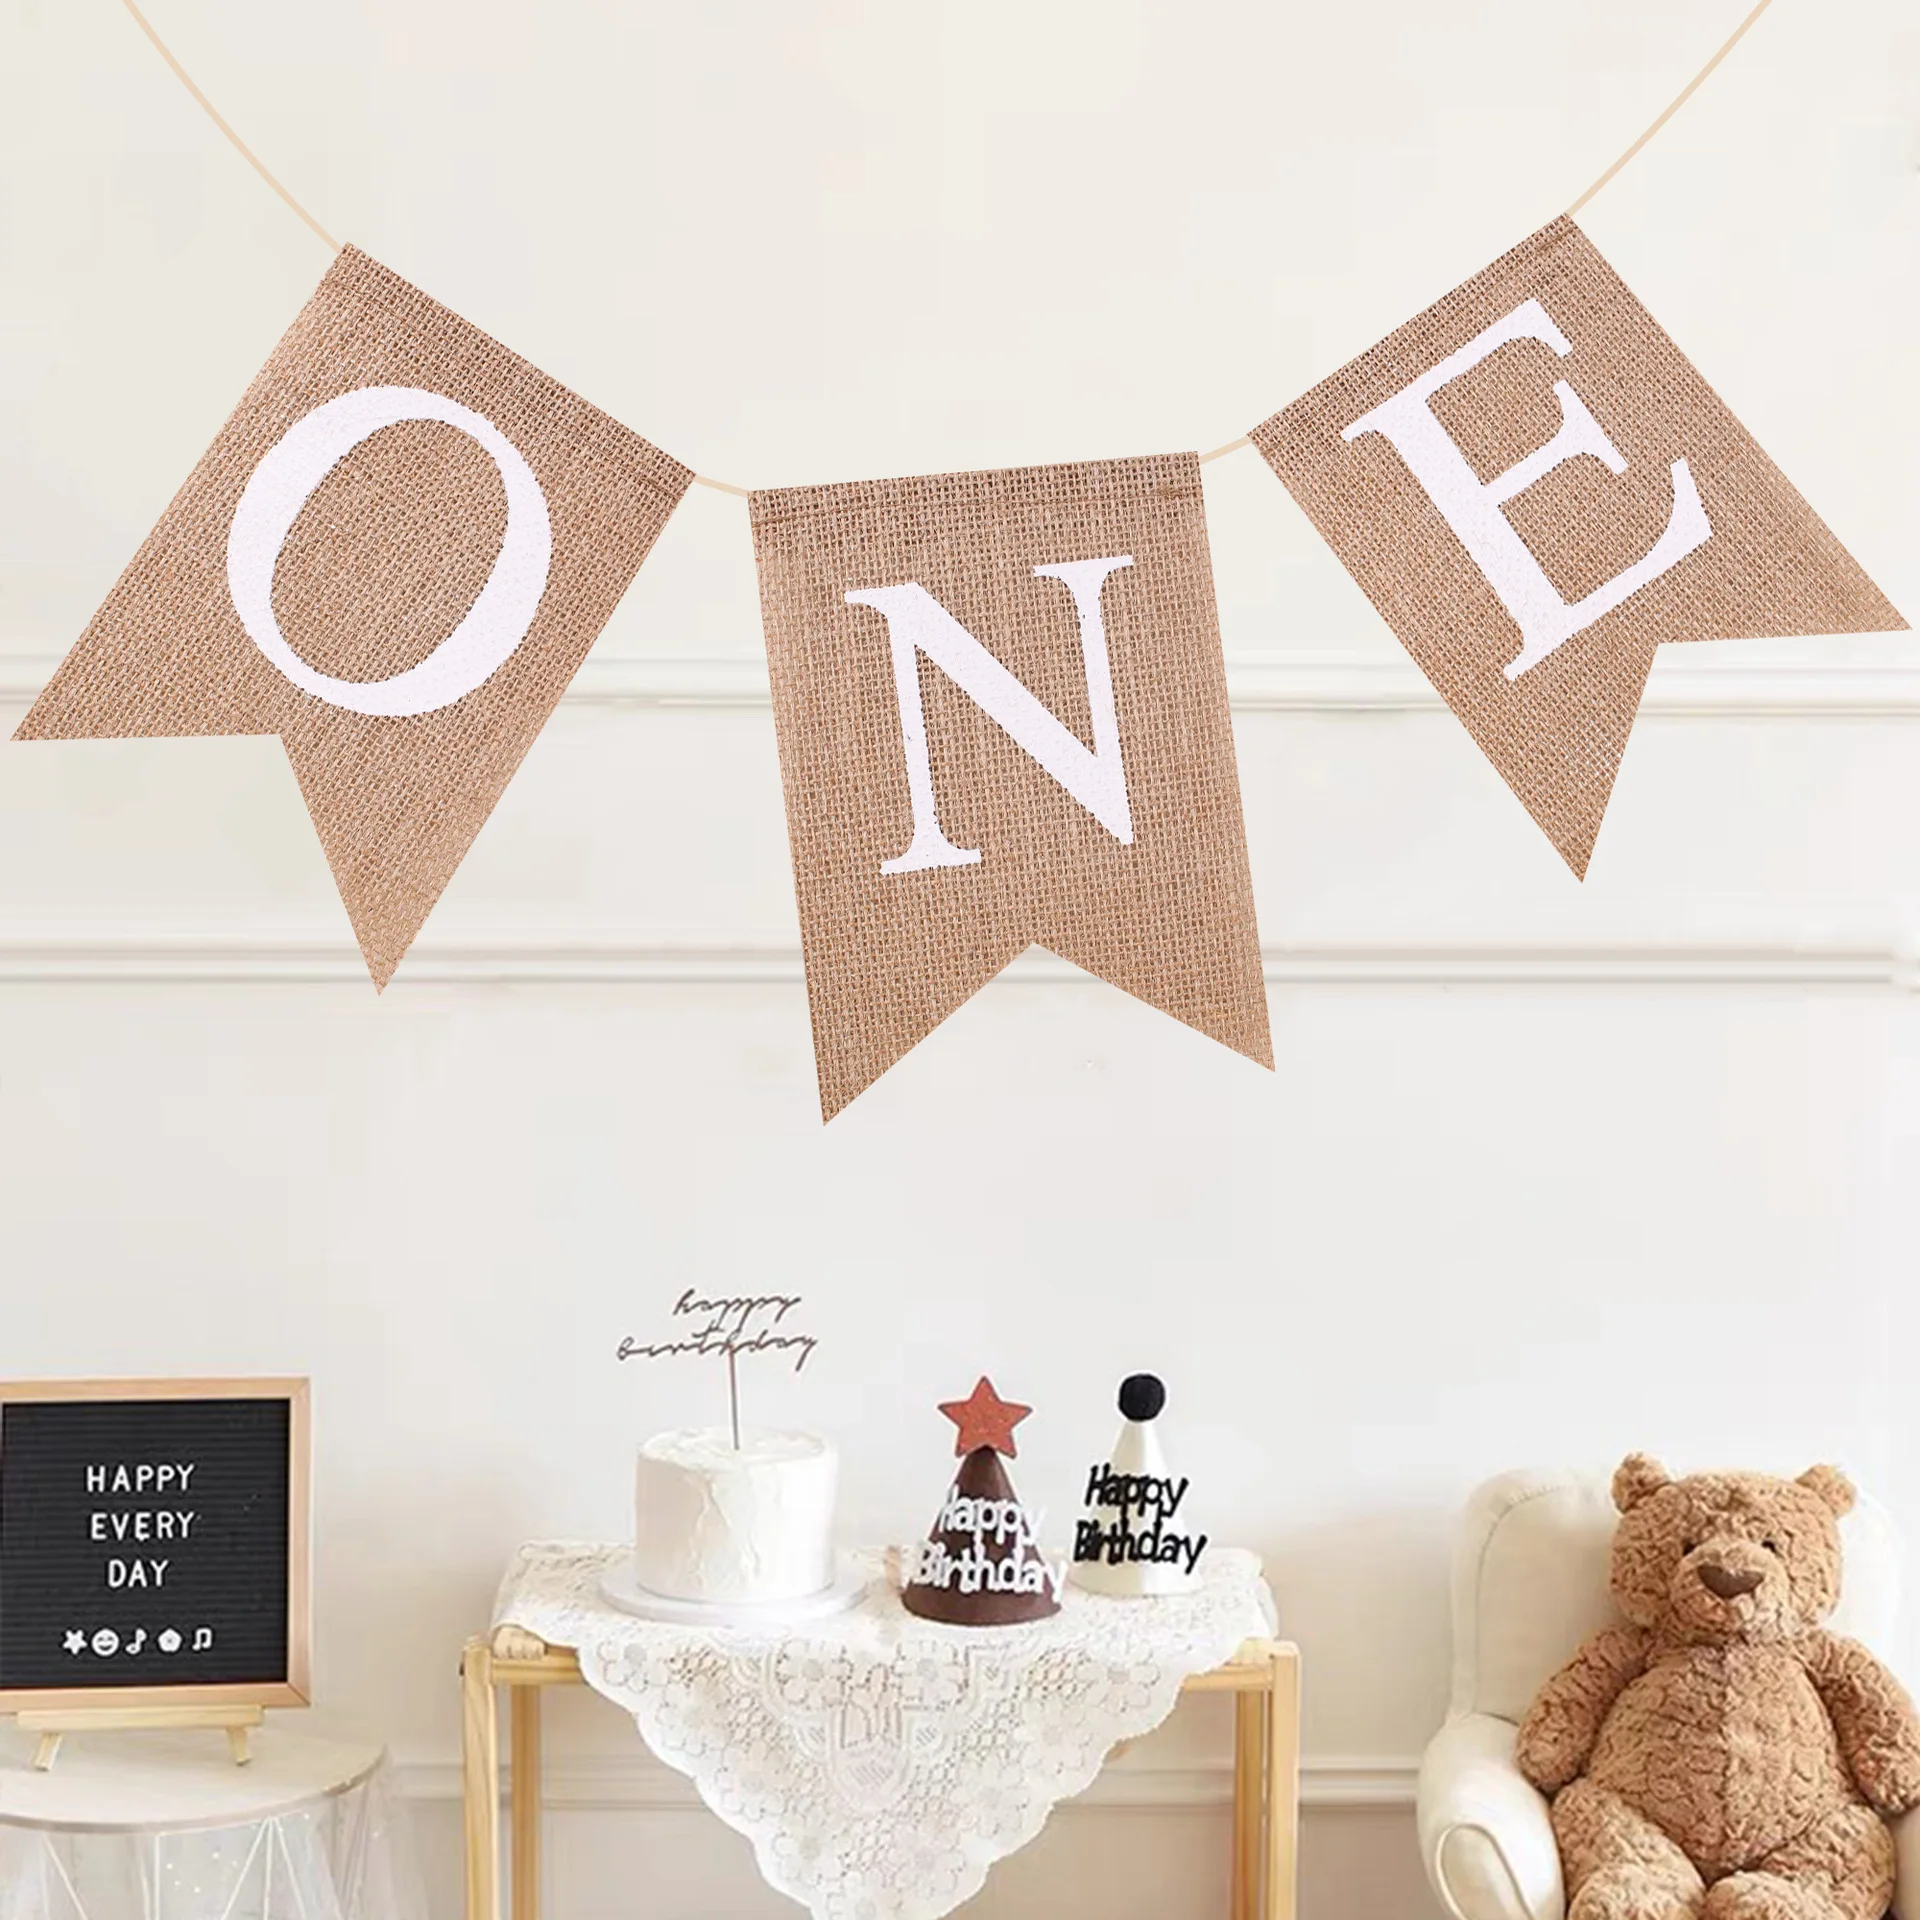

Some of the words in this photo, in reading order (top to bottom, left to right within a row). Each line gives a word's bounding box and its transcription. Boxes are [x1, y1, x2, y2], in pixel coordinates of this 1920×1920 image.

[672, 1288, 802, 1333] happy
[616, 1319, 819, 1372] birthday
[86, 1463, 195, 1493] HAPPY
[1084, 1462, 1189, 1519] Happy
[90, 1511, 195, 1541] EVERY
[1072, 1519, 1208, 1575] Birthday
[107, 1559, 169, 1588] DAY
[910, 1541, 1069, 1604] Birthday
